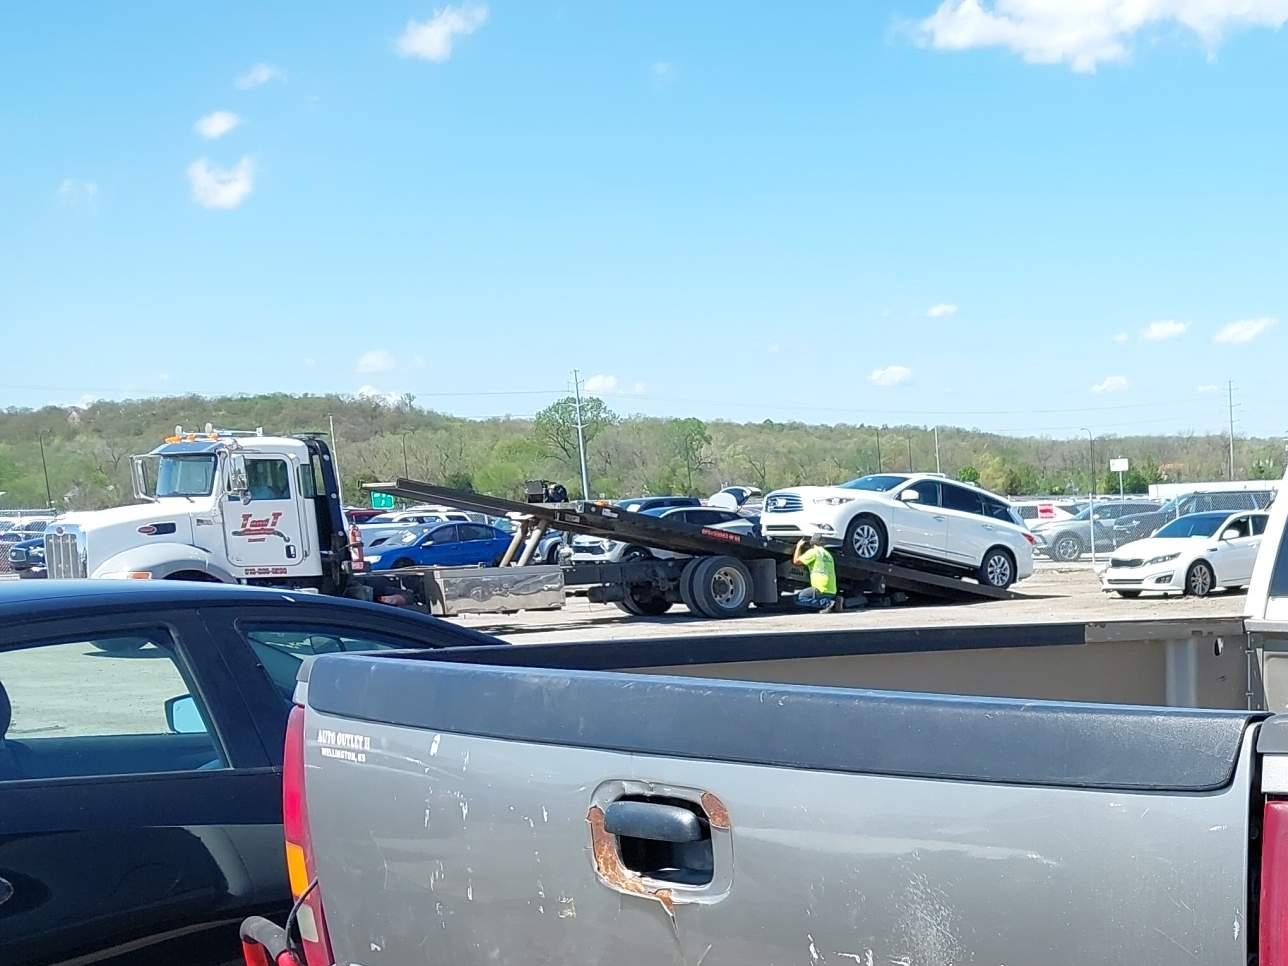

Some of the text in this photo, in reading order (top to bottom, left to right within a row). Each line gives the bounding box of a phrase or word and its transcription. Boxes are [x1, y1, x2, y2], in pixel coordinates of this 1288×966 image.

[271, 512, 282, 527] T
[318, 729, 336, 745] AUTO
[336, 732, 364, 750] OUTLET
